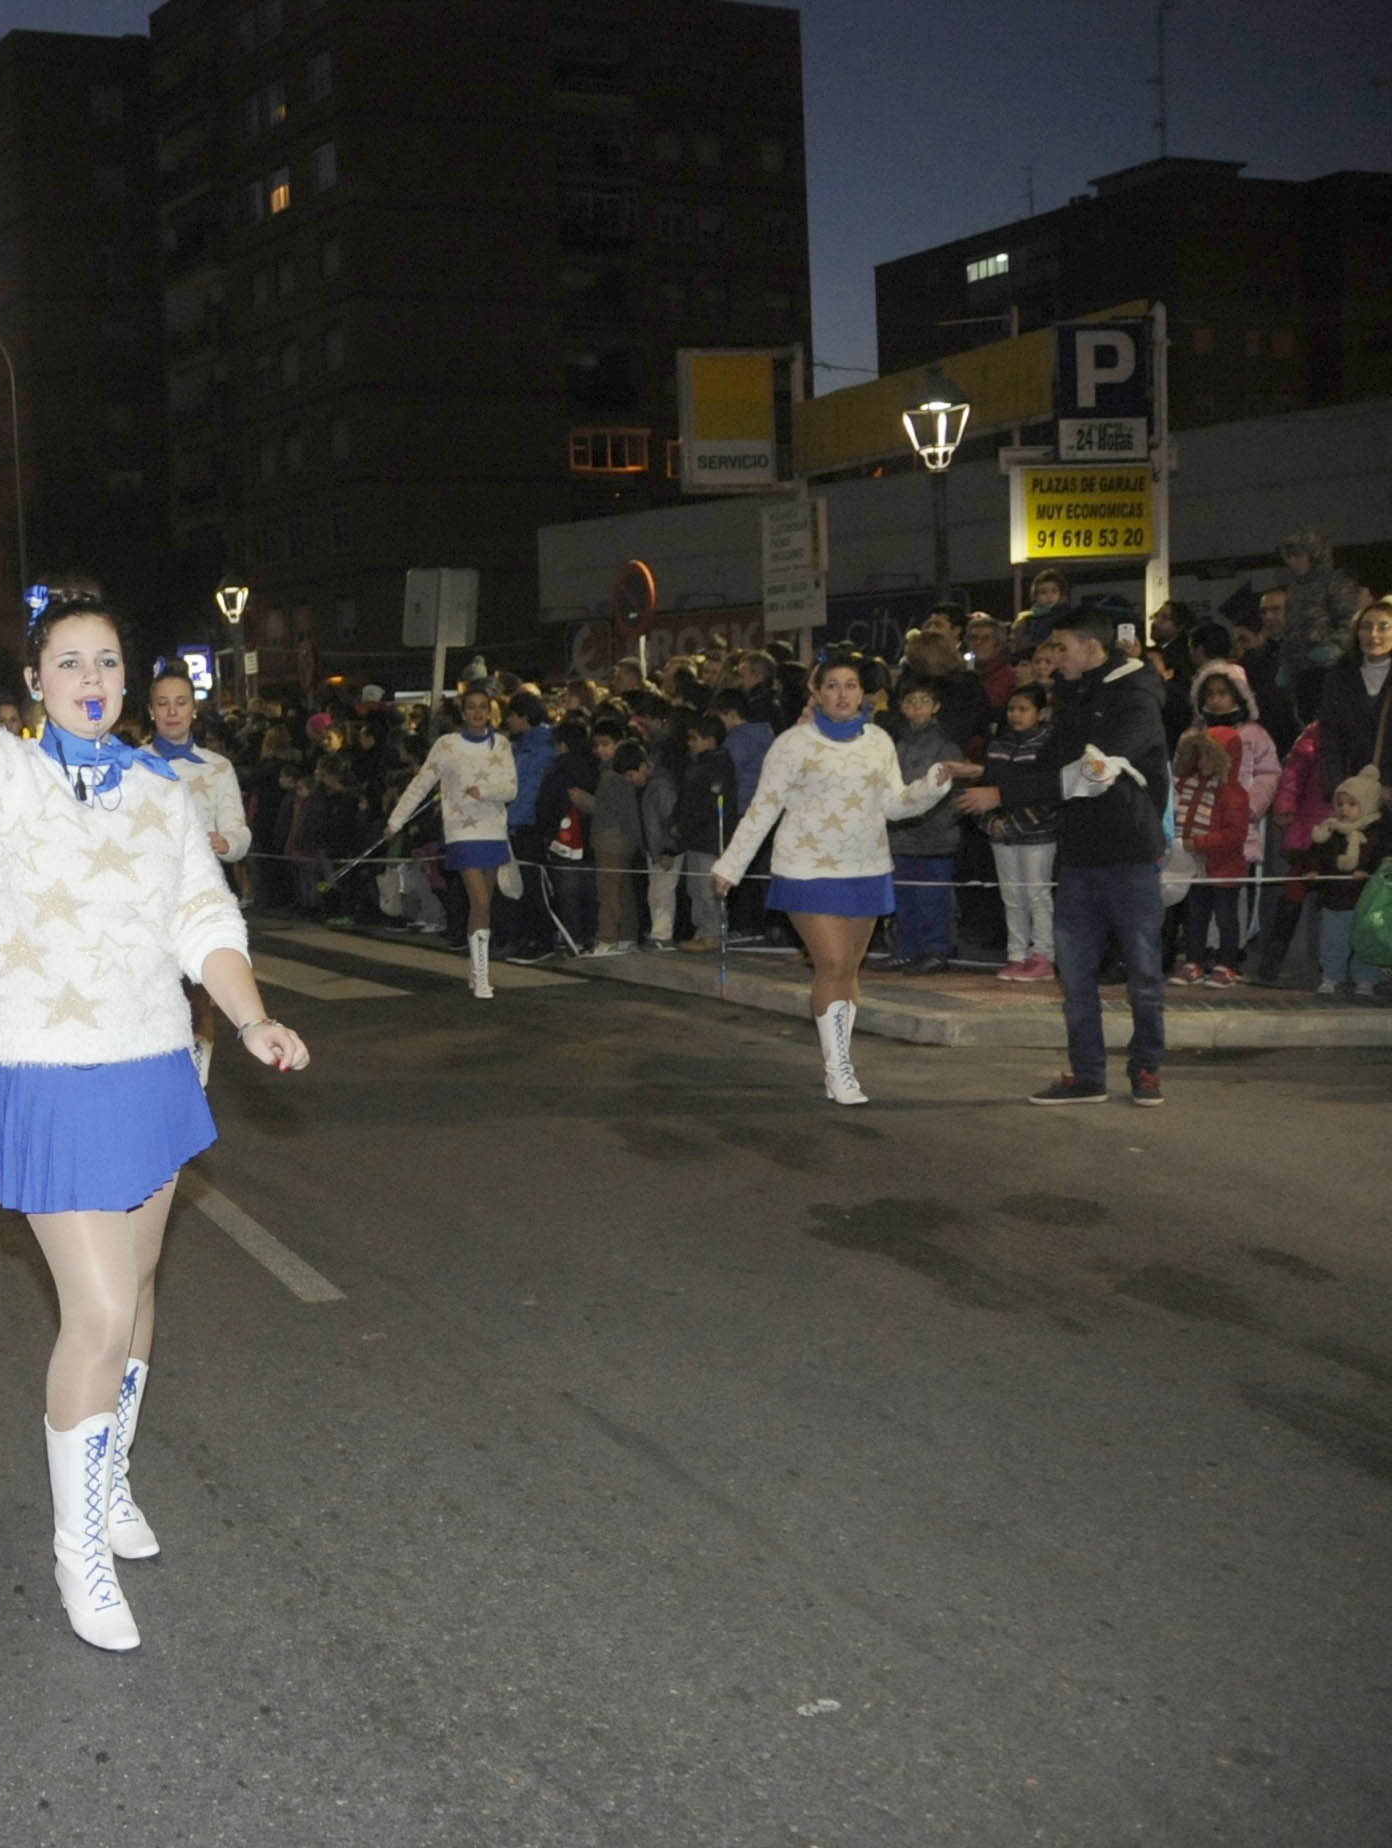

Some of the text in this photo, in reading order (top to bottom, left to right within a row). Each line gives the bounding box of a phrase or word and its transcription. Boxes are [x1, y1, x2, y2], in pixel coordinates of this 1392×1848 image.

[1075, 329, 1136, 408] P
[1076, 429, 1093, 450] 24
[697, 454, 769, 470] SERVICIO
[1032, 475, 1146, 493] PLAZAS DE GARAJE
[1036, 502, 1144, 520] MUY ECONOMICAS
[1037, 528, 1144, 548] 91 618 53 20
